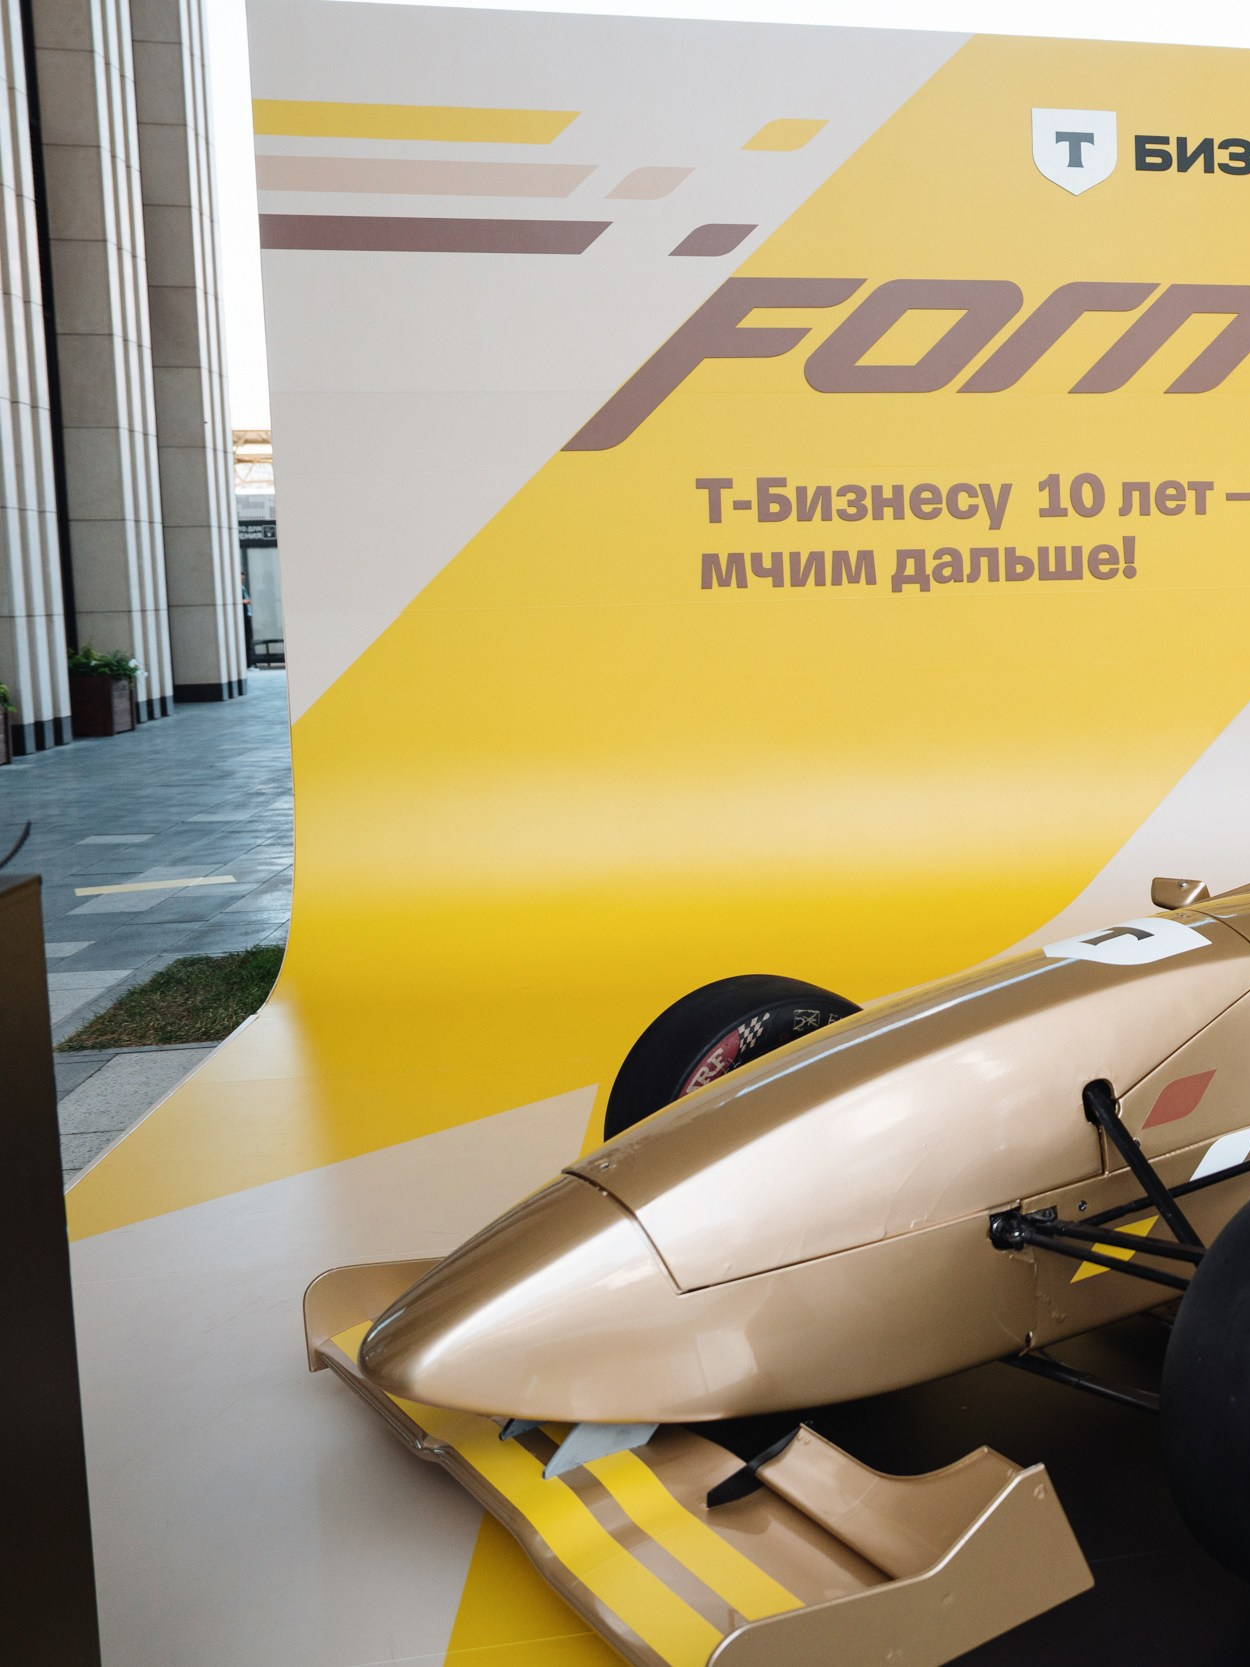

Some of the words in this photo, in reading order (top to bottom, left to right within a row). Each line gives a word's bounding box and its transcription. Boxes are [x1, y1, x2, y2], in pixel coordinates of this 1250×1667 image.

[695, 476, 1013, 531] Т-Бизнесу
[1037, 472, 1106, 517] 10
[1118, 479, 1214, 517] лет
[701, 549, 877, 589] мчим
[892, 536, 1137, 592] дальше!
